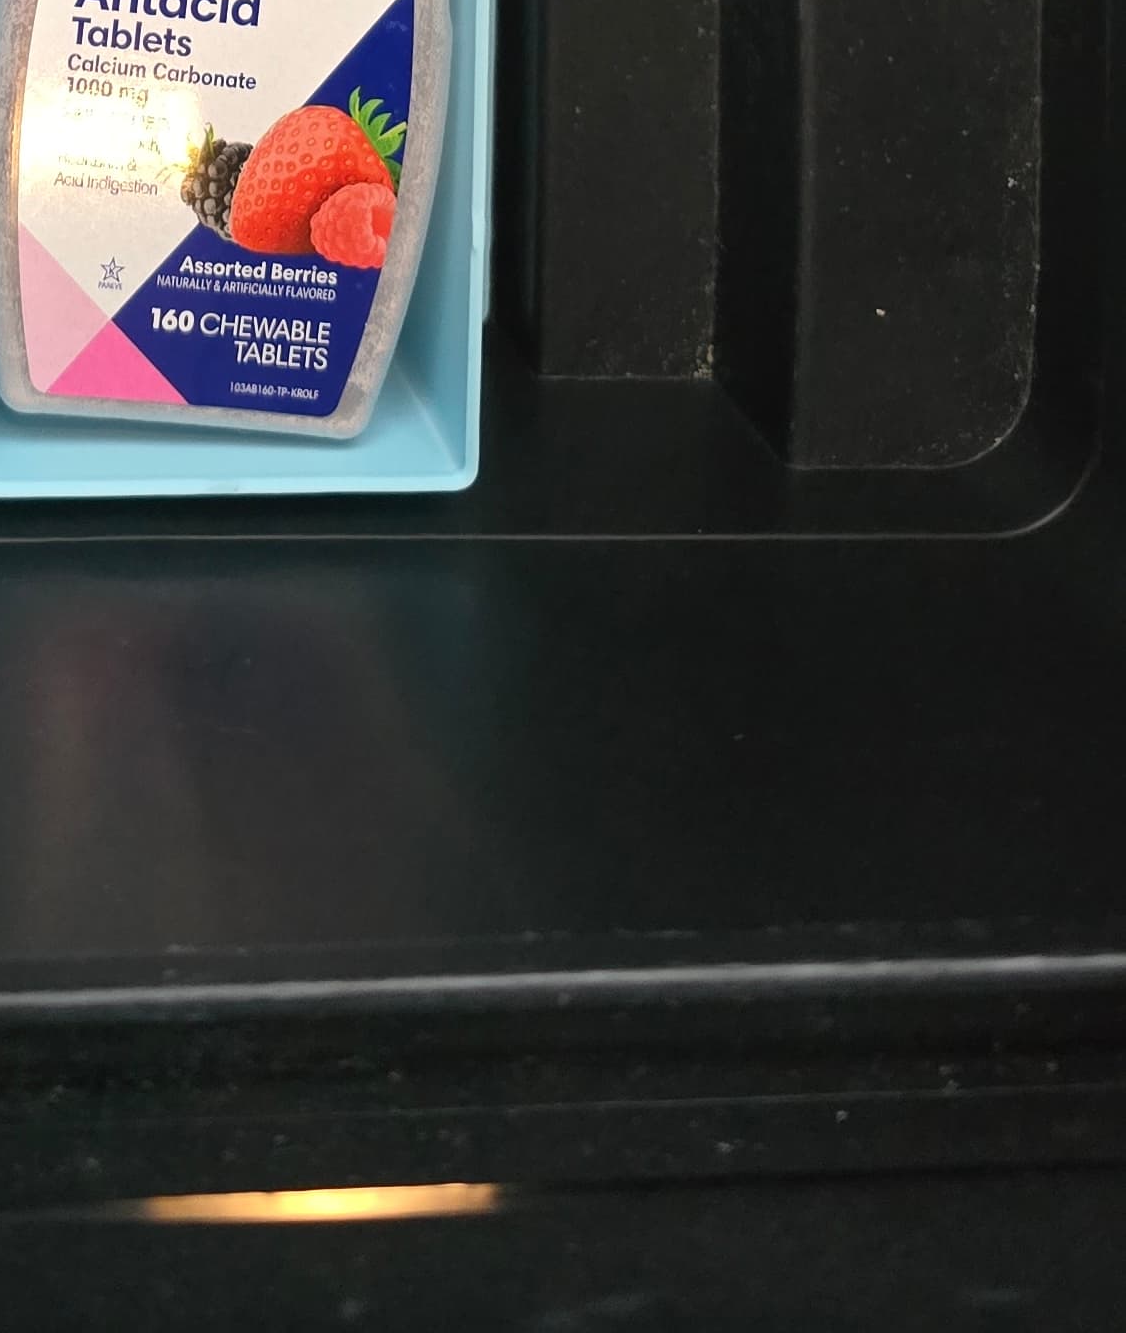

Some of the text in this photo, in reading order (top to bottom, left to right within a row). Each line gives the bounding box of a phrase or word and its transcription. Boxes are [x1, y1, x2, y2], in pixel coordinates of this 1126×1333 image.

[72, 16, 192, 57] Tablets
[67, 76, 113, 97] 1000
[68, 53, 257, 90] Calcium Carbonate
[53, 171, 158, 196] Acid Indigestion
[179, 255, 338, 285] Assorted Berries
[156, 274, 336, 302] NATURALLY & ARTIFICIALLY FLAVORED
[151, 307, 331, 345] 160 CHEWABLE
[234, 340, 328, 370] TABLETS
[229, 381, 319, 401] 103AB160-TP-KROLF
